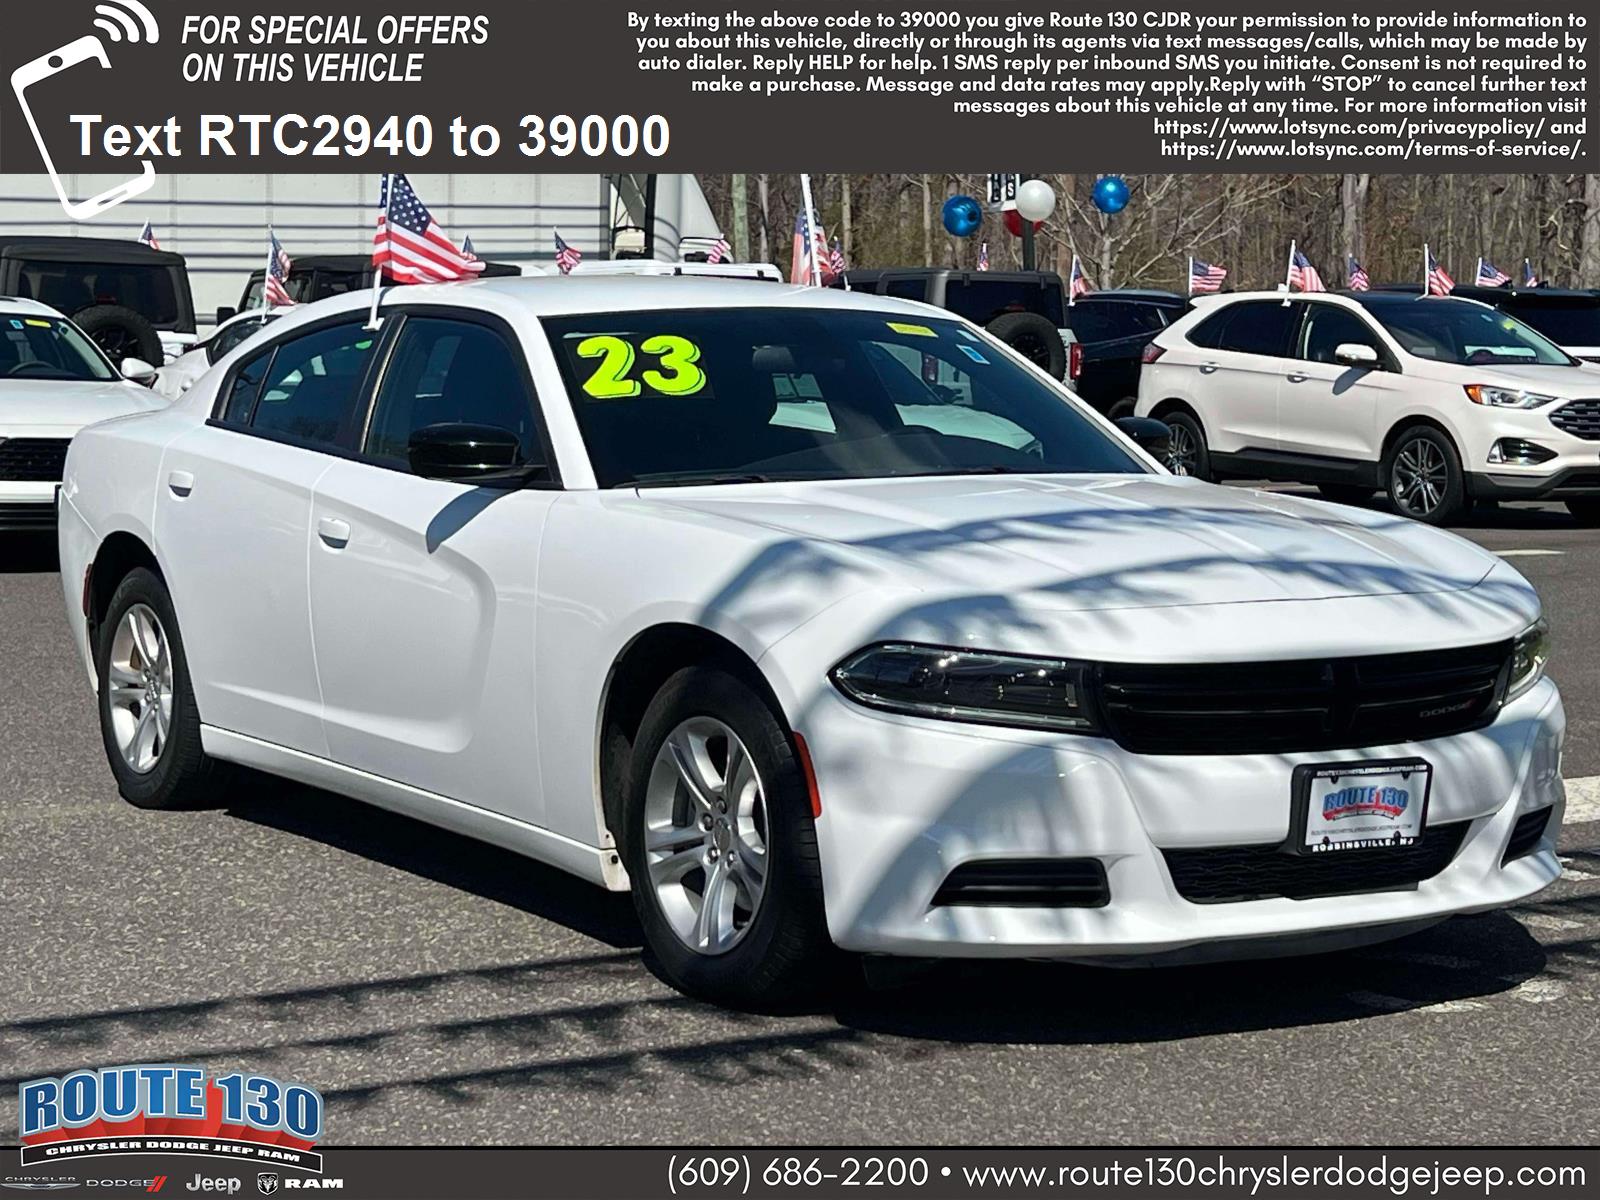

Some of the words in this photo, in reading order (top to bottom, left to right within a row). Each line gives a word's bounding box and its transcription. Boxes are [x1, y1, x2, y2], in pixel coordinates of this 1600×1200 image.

[576, 333, 708, 399] 23
[1324, 787, 1377, 809] ROUTE
[1381, 786, 1410, 808] 130
[1399, 837, 1415, 846] NJ
